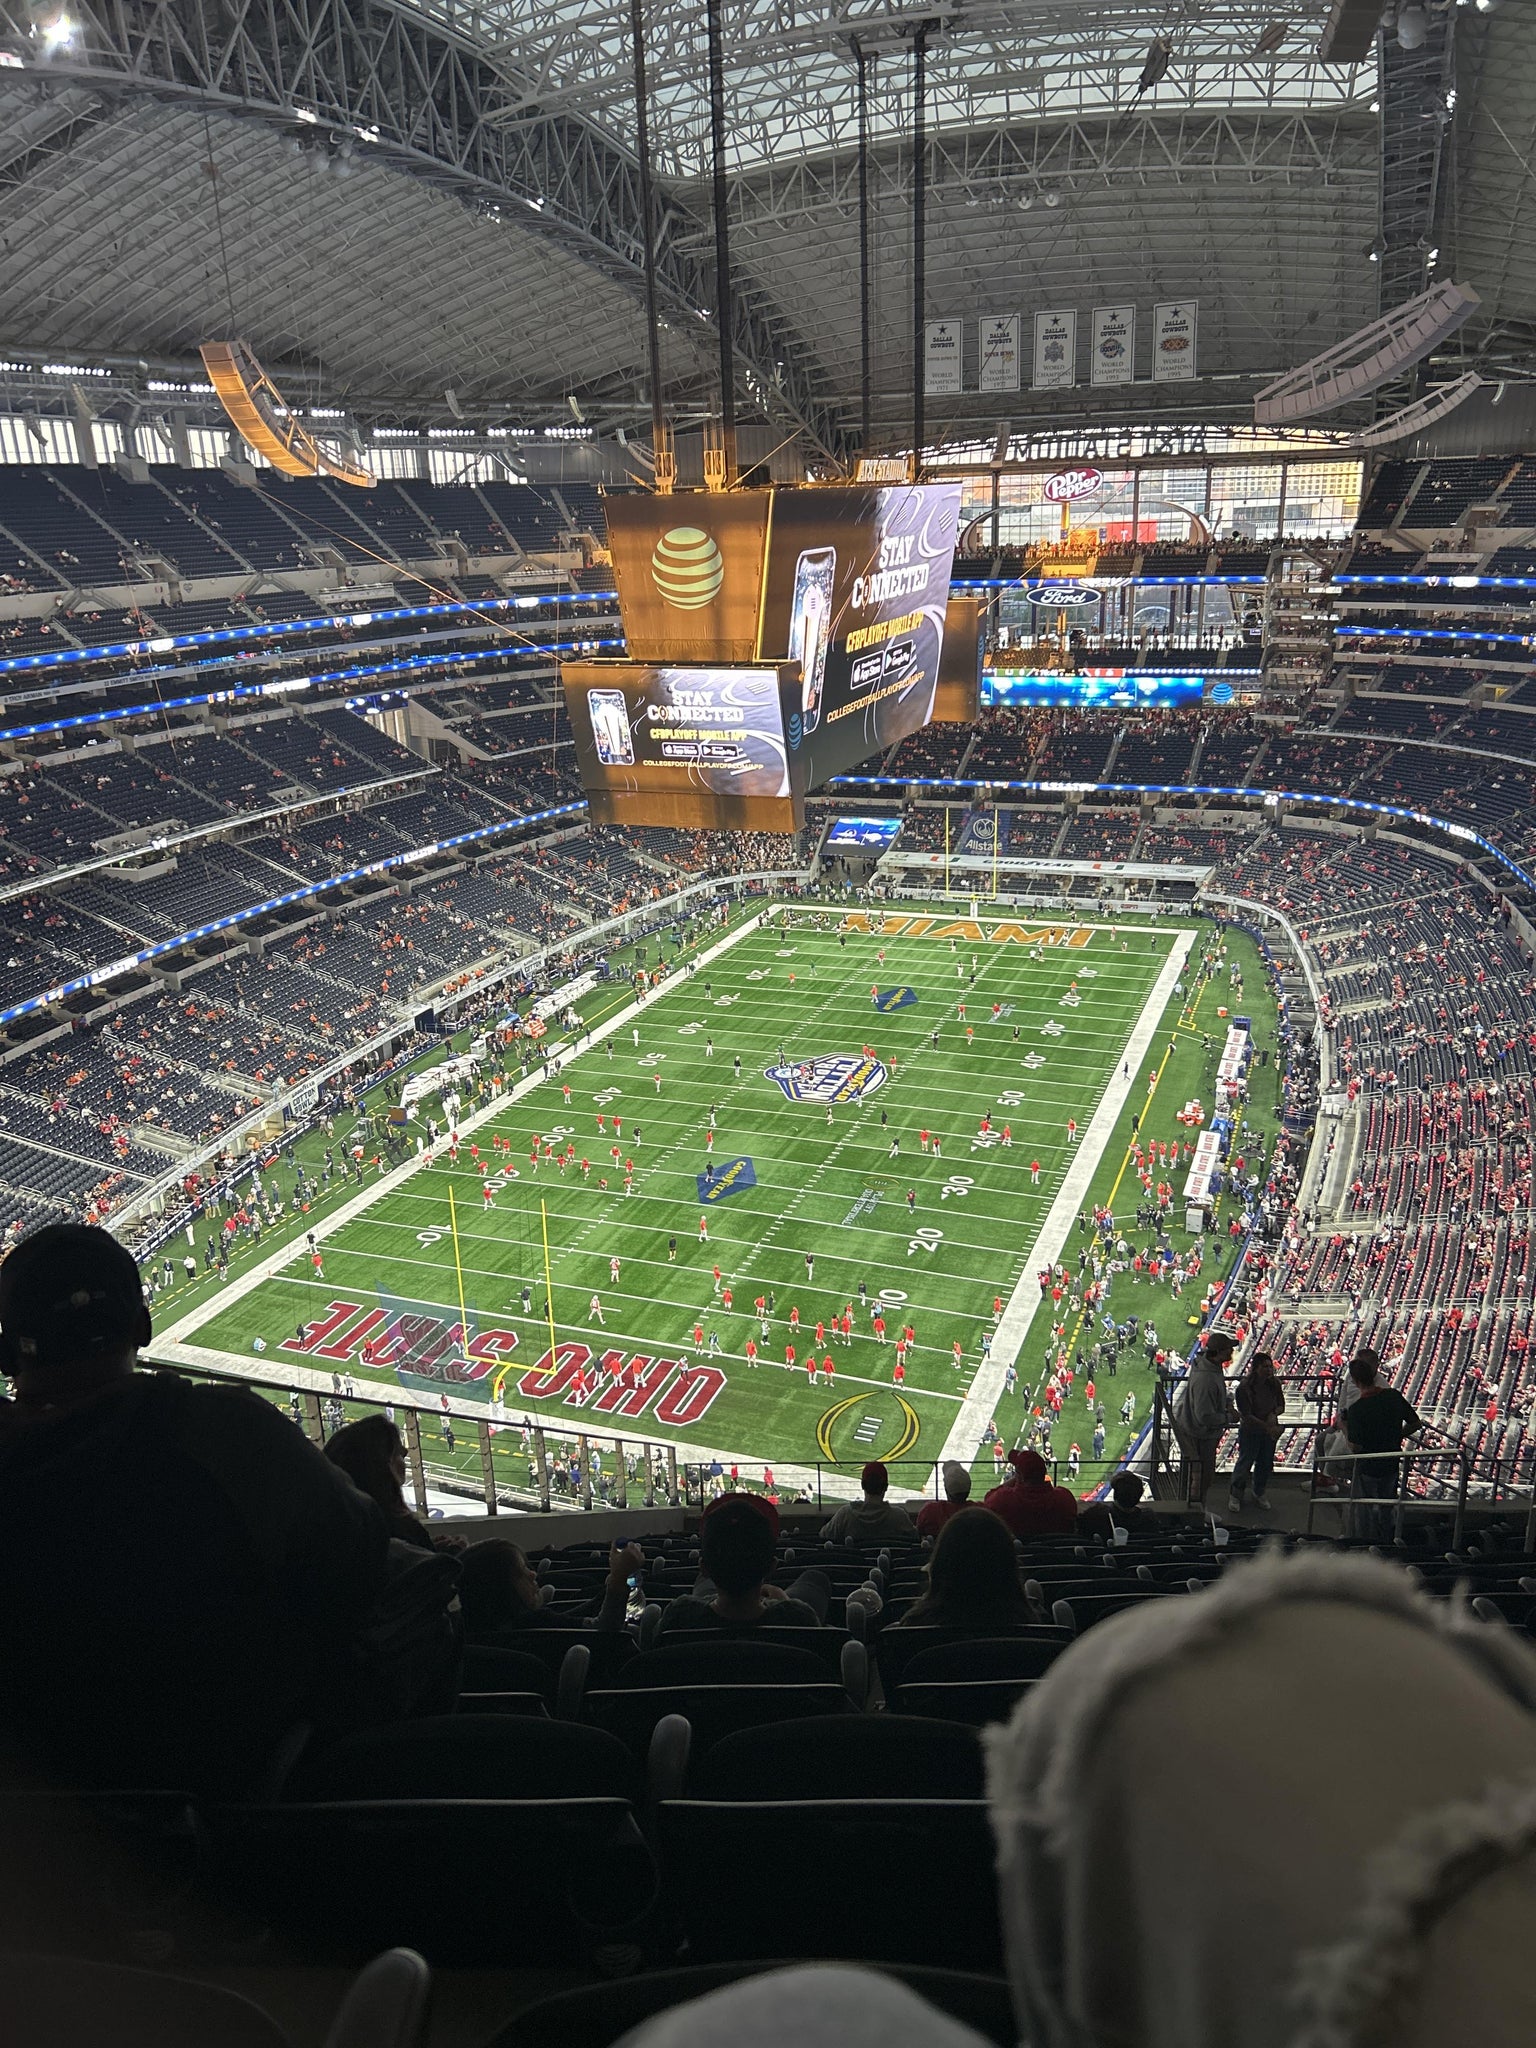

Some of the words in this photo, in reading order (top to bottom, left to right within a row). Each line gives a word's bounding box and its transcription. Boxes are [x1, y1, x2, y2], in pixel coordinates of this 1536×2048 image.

[1100, 329, 1126, 337] COWBOYS
[1162, 326, 1188, 334] COWBOYS
[1156, 364, 1192, 373] CHAMPIONS
[1065, 471, 1087, 486] Dr
[1051, 475, 1100, 499] Pepper
[879, 535, 915, 569] STAY
[851, 563, 930, 609] CONNECTED
[1041, 588, 1086, 604] Ford
[846, 622, 889, 654] CFBPLAYOFF
[887, 612, 912, 640] MOBILE
[671, 691, 714, 706] STAY
[647, 705, 744, 722] CONNECTED
[649, 728, 698, 740] CFBPLAYOFF
[1265, 794, 1279, 806] 22
[983, 859, 1074, 868] GOODYEAR
[832, 914, 1096, 947] MIAMI
[714, 994, 737, 1006] 30
[1058, 994, 1082, 1008] 20
[678, 1022, 704, 1035] 40
[1040, 1023, 1065, 1037] 30
[637, 1052, 666, 1066] 50
[1020, 1055, 1046, 1069] 40
[798, 1058, 864, 1100] COTTON
[293, 1087, 316, 1106] COTTON
[593, 1086, 622, 1102] 40
[997, 1090, 1025, 1106] 50
[294, 1099, 313, 1114] BOWL
[541, 1125, 575, 1143] 30
[972, 1130, 1002, 1147] 40
[706, 1161, 746, 1199] GOODYEAR
[942, 1175, 975, 1196] 30
[416, 1224, 452, 1241] 10
[909, 1227, 944, 1252] 20
[877, 1289, 908, 1310] 10
[276, 1300, 520, 1385] STATE
[517, 1341, 728, 1427] OHIO
